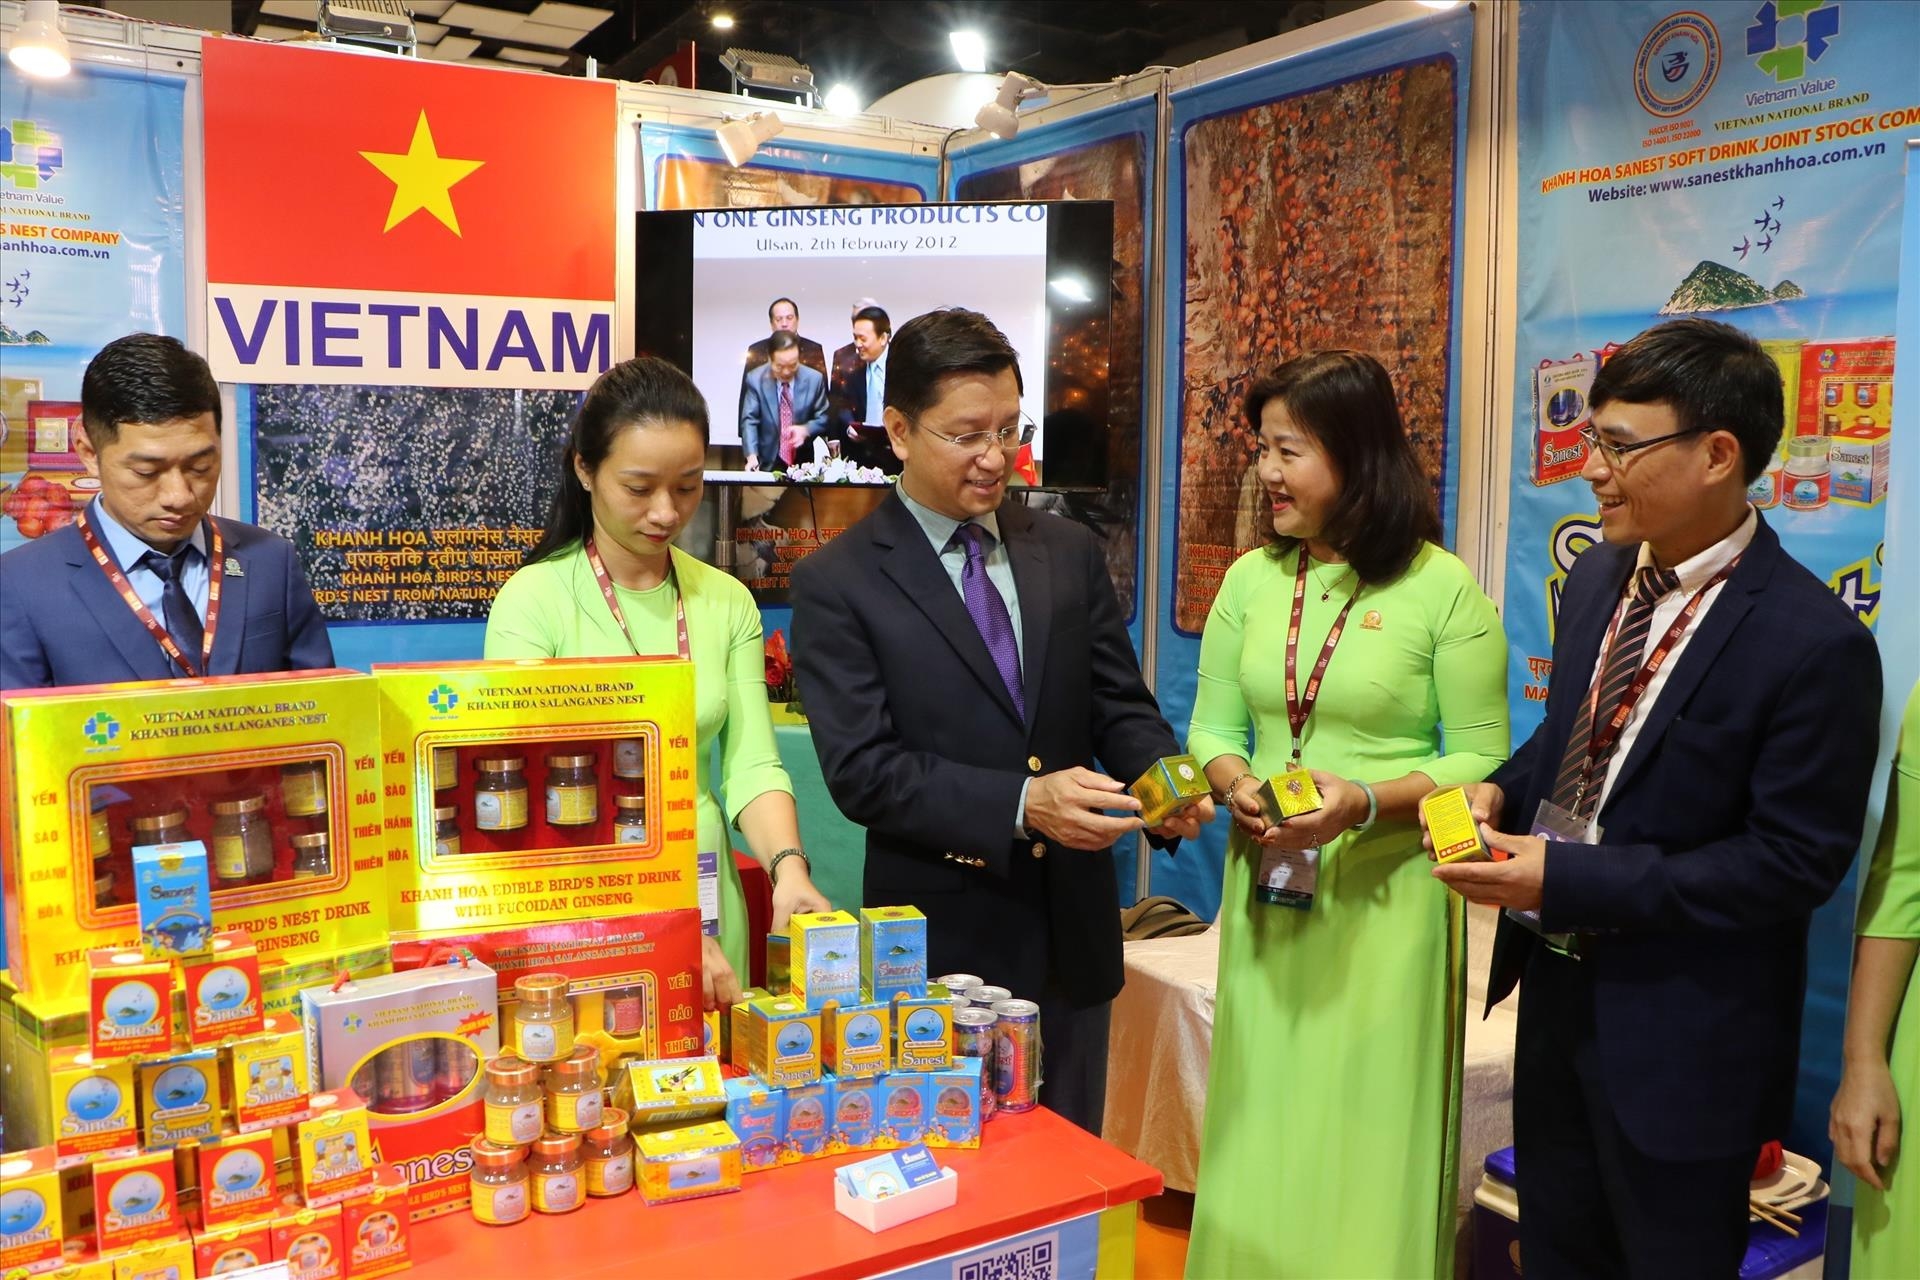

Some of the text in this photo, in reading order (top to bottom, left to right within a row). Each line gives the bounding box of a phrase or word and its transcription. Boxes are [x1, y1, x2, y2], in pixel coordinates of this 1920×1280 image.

[1745, 79, 1836, 106] Vietnam Value
[1714, 93, 1870, 131] VIETNAM NATIONAL BRAND
[1541, 171, 1576, 194] KHANH
[1579, 167, 1612, 184] HOA
[1615, 156, 1666, 179] SANEST
[1668, 149, 1706, 168] SOFT
[1709, 139, 1759, 162] DRINK
[1761, 129, 1811, 152] JOINT
[1815, 117, 1874, 142] STOCK
[1588, 141, 1886, 203] Website: www.sanestkhanhhoa.com.vn
[36, 193, 64, 205] Value
[10, 207, 58, 218] NATIONAL
[60, 211, 91, 221] BRAND
[713, 211, 758, 228] ONE
[766, 208, 862, 228] GINSENG
[871, 206, 999, 226] PRODUCTS
[1007, 204, 1045, 223] CO
[10, 224, 48, 238] NEST
[51, 227, 120, 245] COMPANY
[755, 238, 804, 253] Ulsan,
[811, 237, 836, 251] 2th
[915, 236, 958, 250] 2012
[213, 296, 611, 374] VIETNAM
[1543, 438, 1585, 467] Sanest
[1831, 446, 1870, 465] Sanest
[316, 530, 383, 546] KHANH
[389, 530, 428, 546] HOA
[736, 528, 783, 540] KHANH
[788, 528, 816, 541] HOA
[1189, 544, 1232, 560] KHANH
[342, 570, 515, 586] KHANH HOA BIRD'S NES
[313, 587, 499, 604] RD'S NEST FROM NATURA
[1189, 585, 1216, 598] KHAN
[1189, 601, 1211, 614] BIRD
[478, 682, 634, 698] VIETNAM NATIONAL BRAND
[1525, 685, 1549, 701] MA
[143, 700, 316, 724] VIETNAM NATIONAL BRAND
[466, 694, 645, 711] KHANH HOA SALANGANES NEST
[130, 712, 328, 741] KHANH HOA SALANGANES NEST
[669, 733, 689, 749] YẾN
[355, 754, 375, 770] YẾN
[384, 748, 405, 764] YẾN
[400, 870, 682, 904] KHANH HOA EDIBLE BIRD'S NEST DRINK
[455, 892, 633, 919] WITH FUCOIDAN GINSENG
[227, 917, 278, 934] BIRD'S
[282, 909, 321, 928] NEST
[326, 901, 371, 922] DRINK
[255, 930, 320, 953] GINSENG
[668, 971, 693, 990] YẾN
[665, 1036, 698, 1055] THIÊN
[903, 1051, 947, 1067] Sanest
[62, 1110, 129, 1137] Sanest
[152, 1122, 212, 1144] Sanest
[371, 1145, 474, 1185] nes
